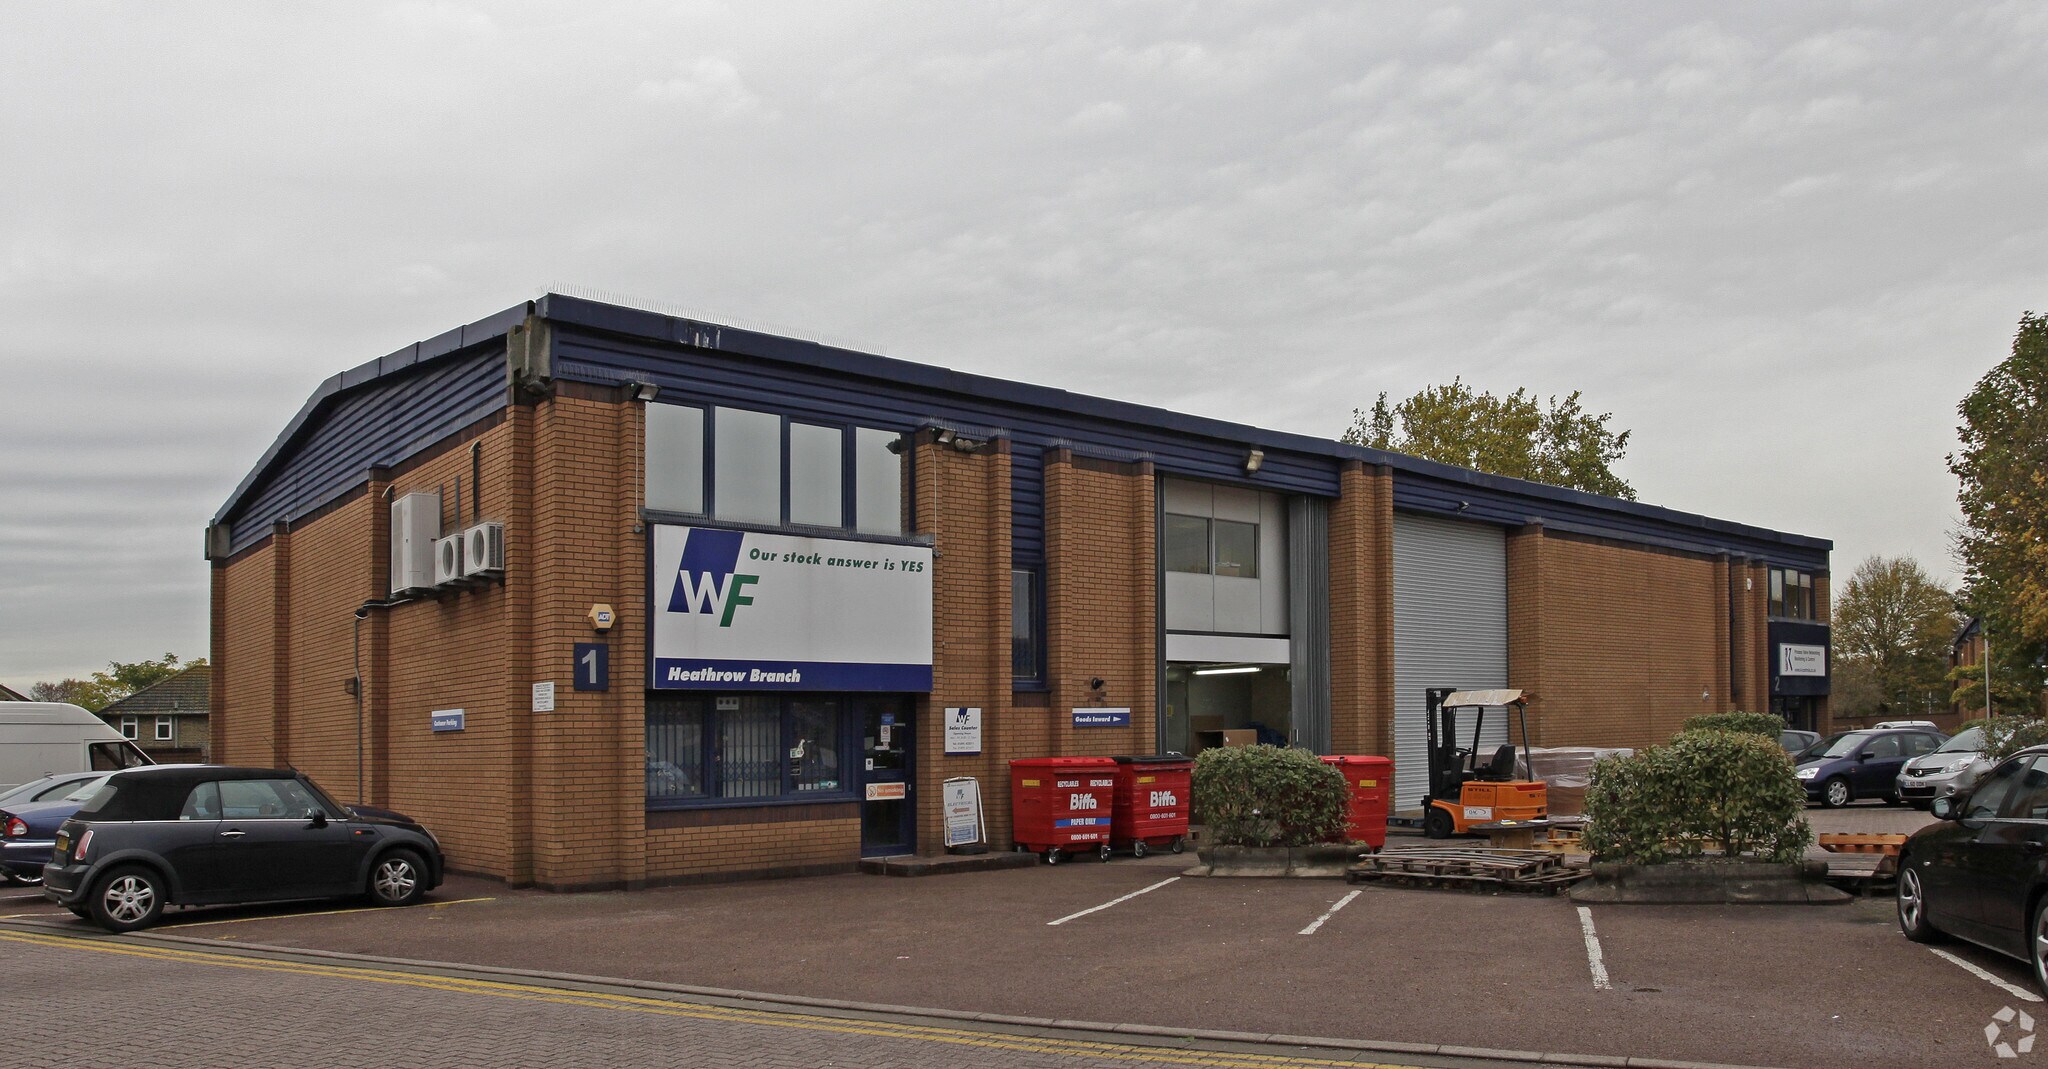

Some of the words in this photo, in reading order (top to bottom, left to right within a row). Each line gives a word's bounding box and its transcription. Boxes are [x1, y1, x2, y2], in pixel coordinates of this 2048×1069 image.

[749, 548, 777, 562] Our
[783, 550, 821, 565] stock
[827, 556, 878, 570] answer
[884, 558, 895, 571] is
[901, 560, 924, 573] YES
[668, 570, 759, 627] WF
[582, 649, 597, 684] 1
[668, 666, 747, 682] Heathrow
[750, 668, 801, 683] Branch
[1774, 676, 1780, 692] 2
[1070, 793, 1097, 810] Biffa
[1150, 791, 1176, 807] Biffa
[1070, 818, 1084, 826] PAPER
